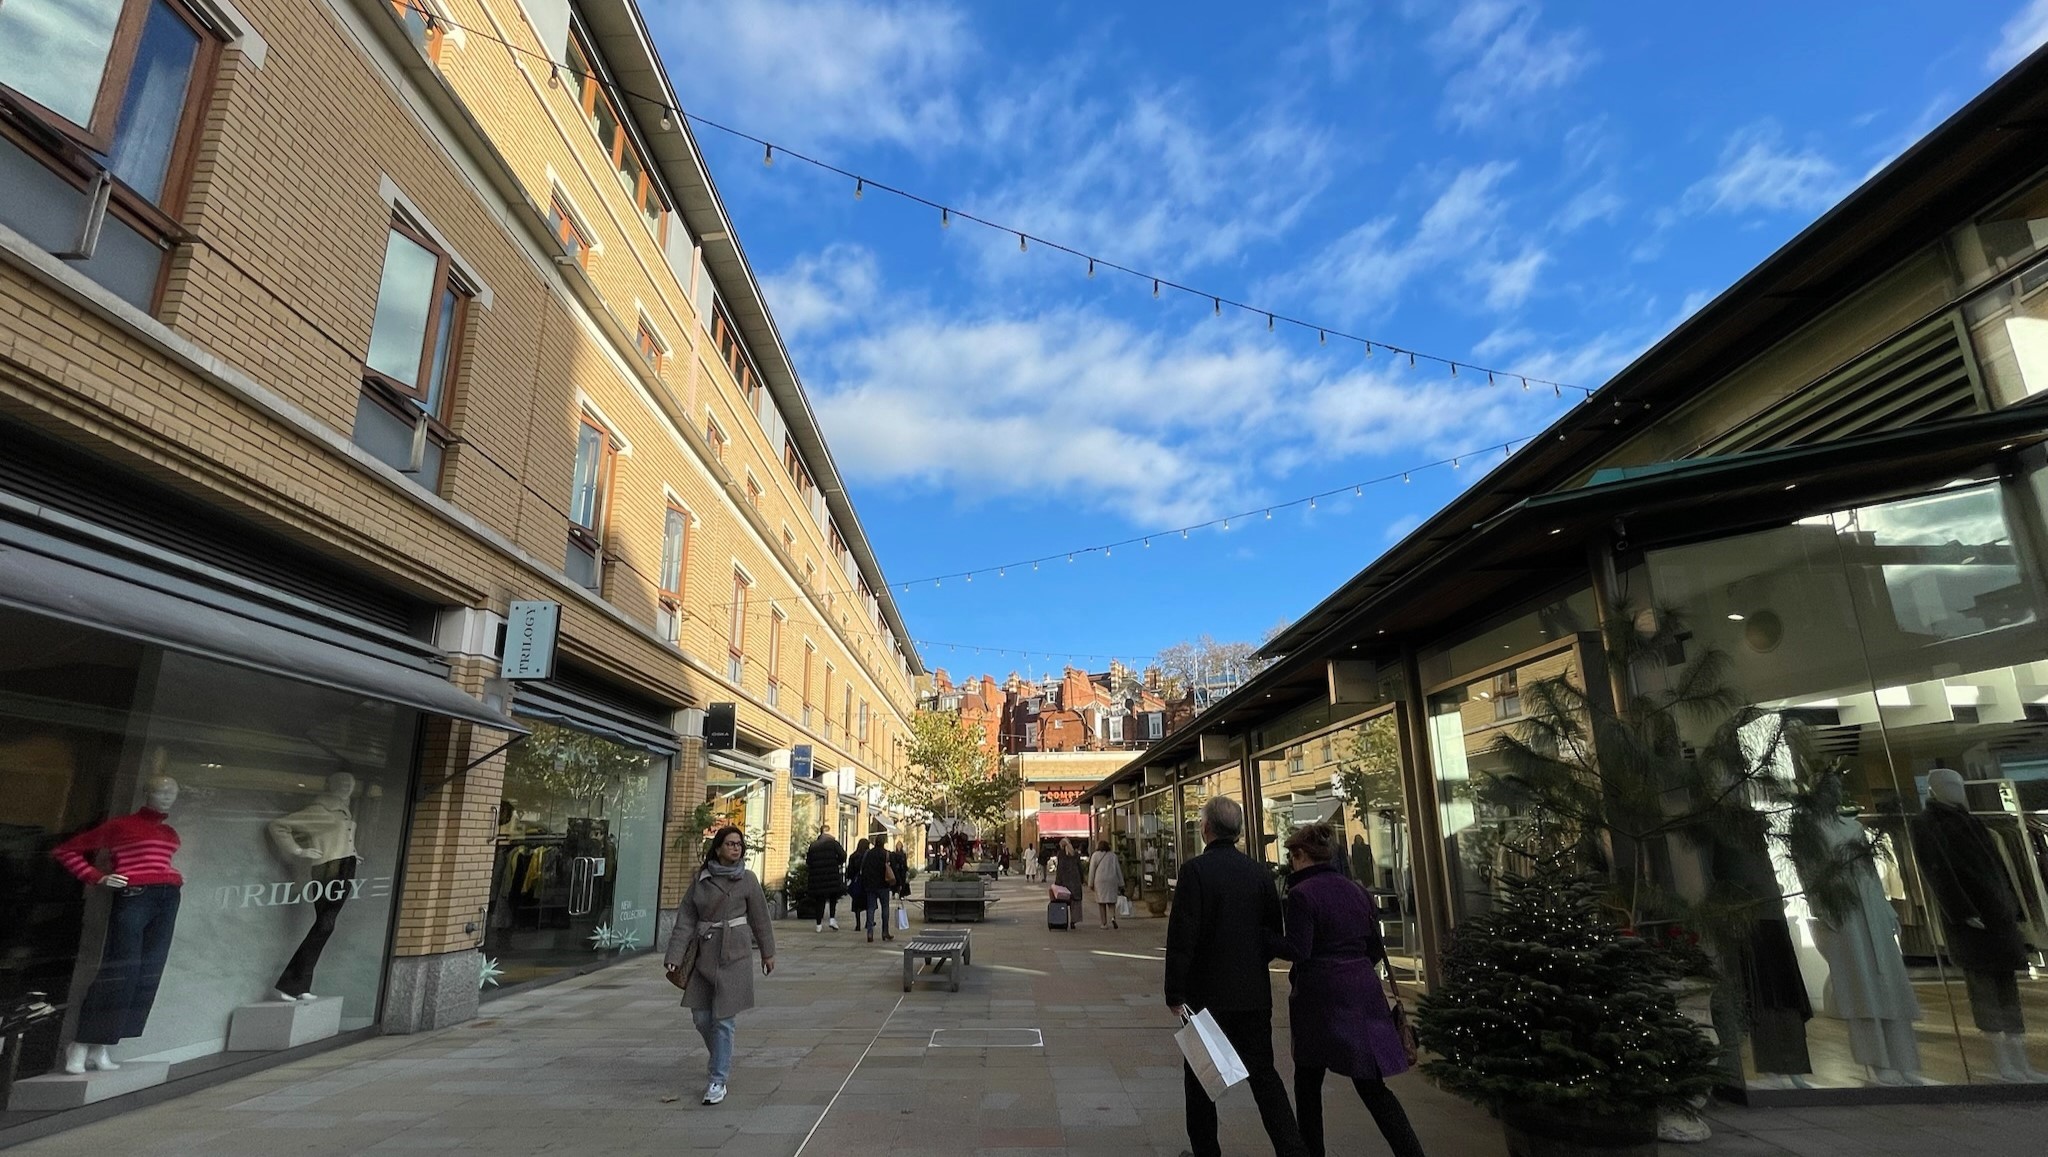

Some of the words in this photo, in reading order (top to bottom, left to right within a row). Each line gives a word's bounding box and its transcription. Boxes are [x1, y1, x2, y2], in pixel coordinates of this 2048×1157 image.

[519, 606, 536, 674] TRILOGY
[215, 878, 367, 909] TRILOGY
[619, 909, 647, 921] COLLECTION
[620, 900, 633, 910] NEW
